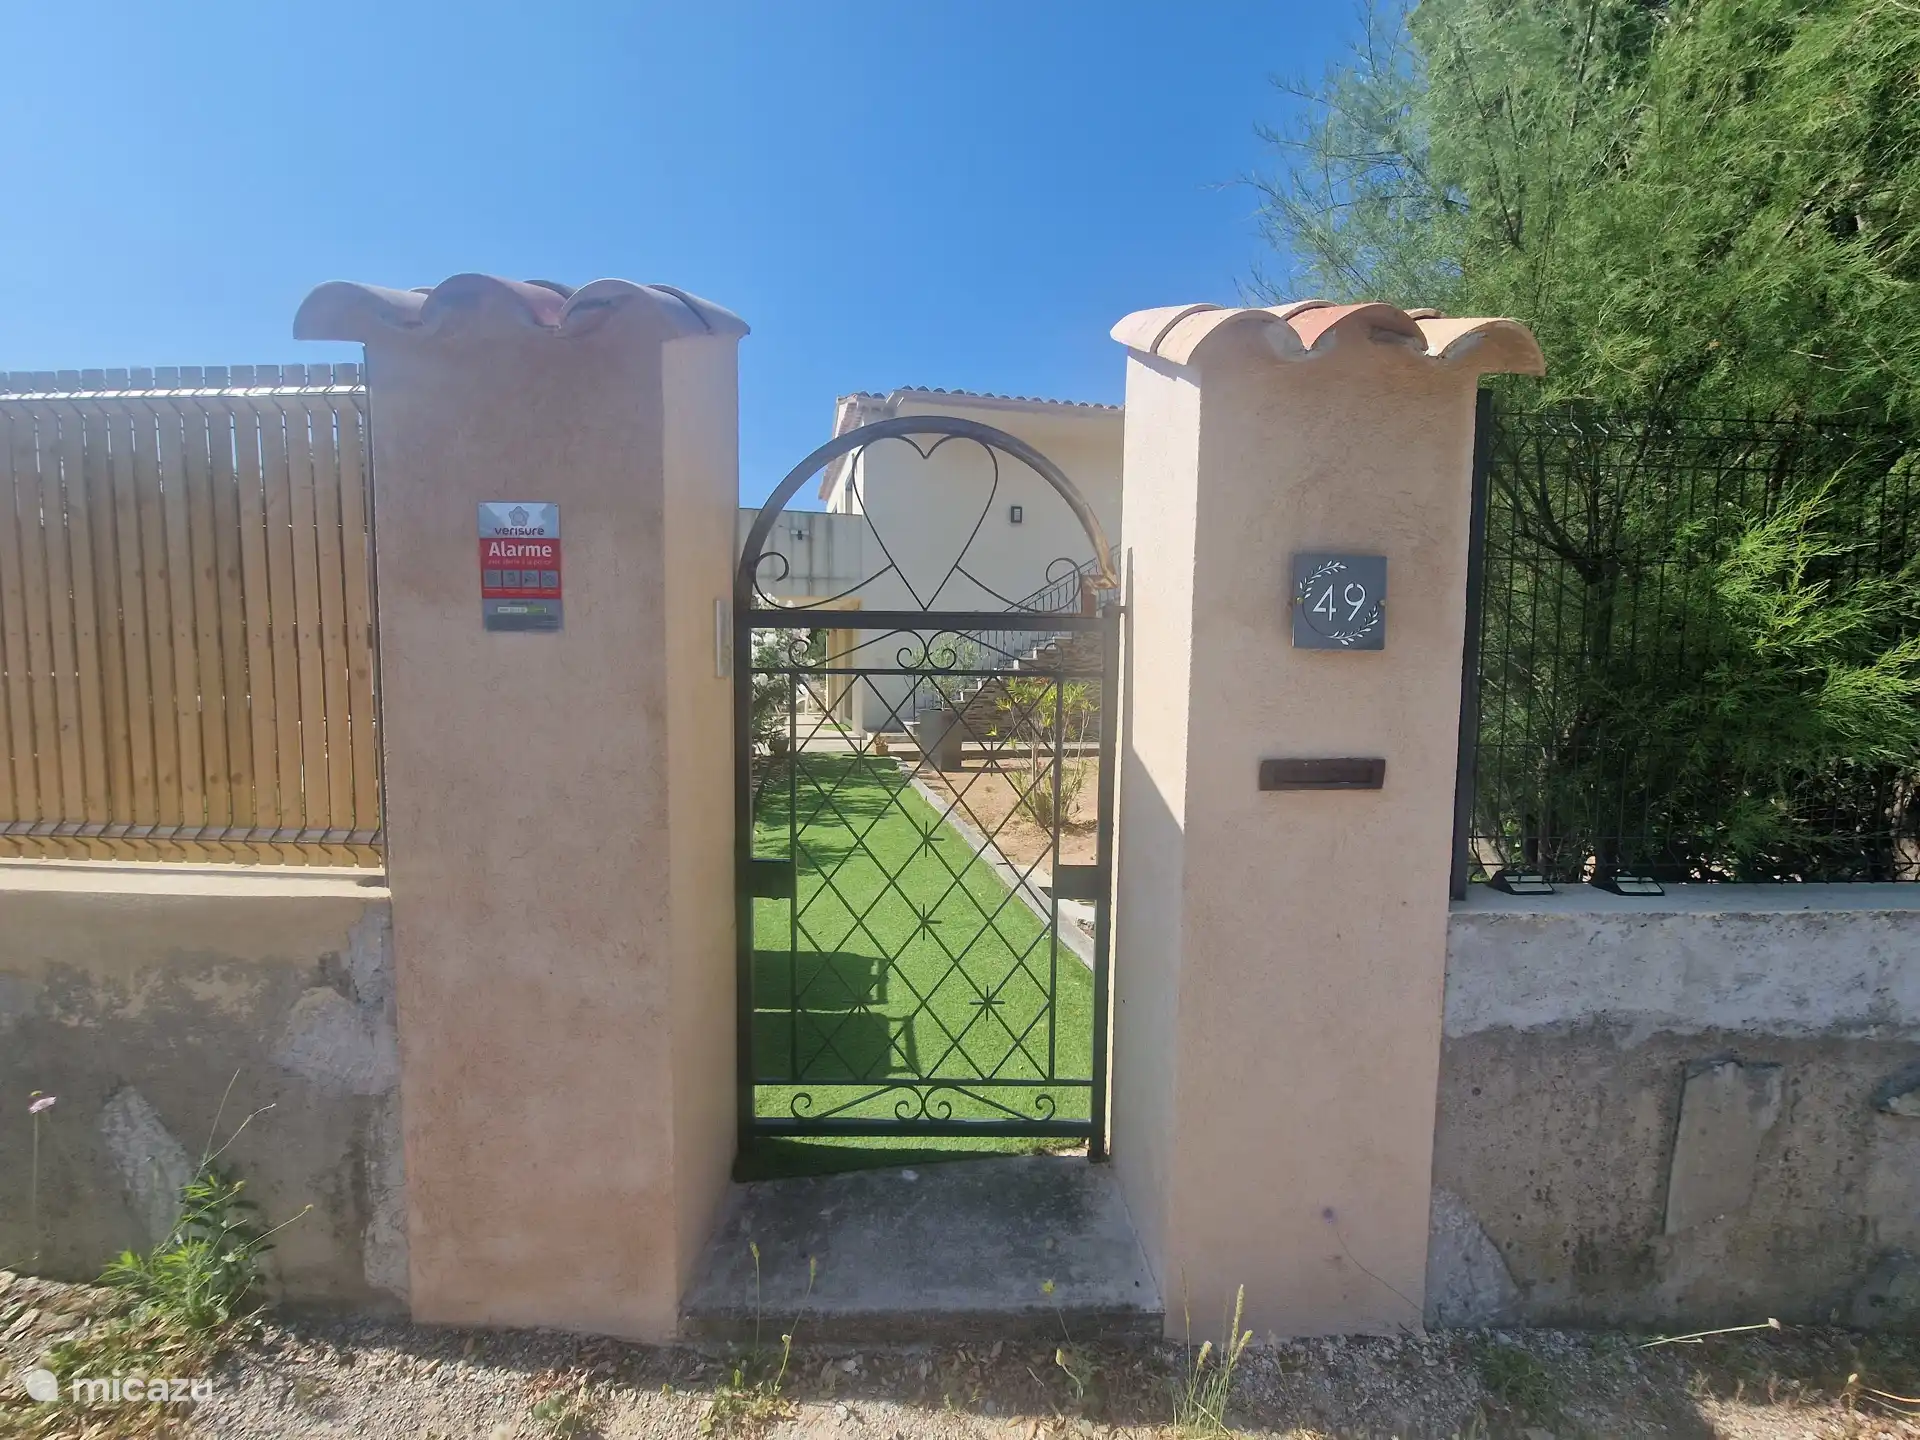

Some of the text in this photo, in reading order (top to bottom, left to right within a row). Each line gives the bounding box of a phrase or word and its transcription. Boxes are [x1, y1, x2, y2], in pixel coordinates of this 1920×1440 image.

[494, 527, 545, 536] verisure
[489, 541, 552, 557] Alarme
[1312, 583, 1366, 621] 49
